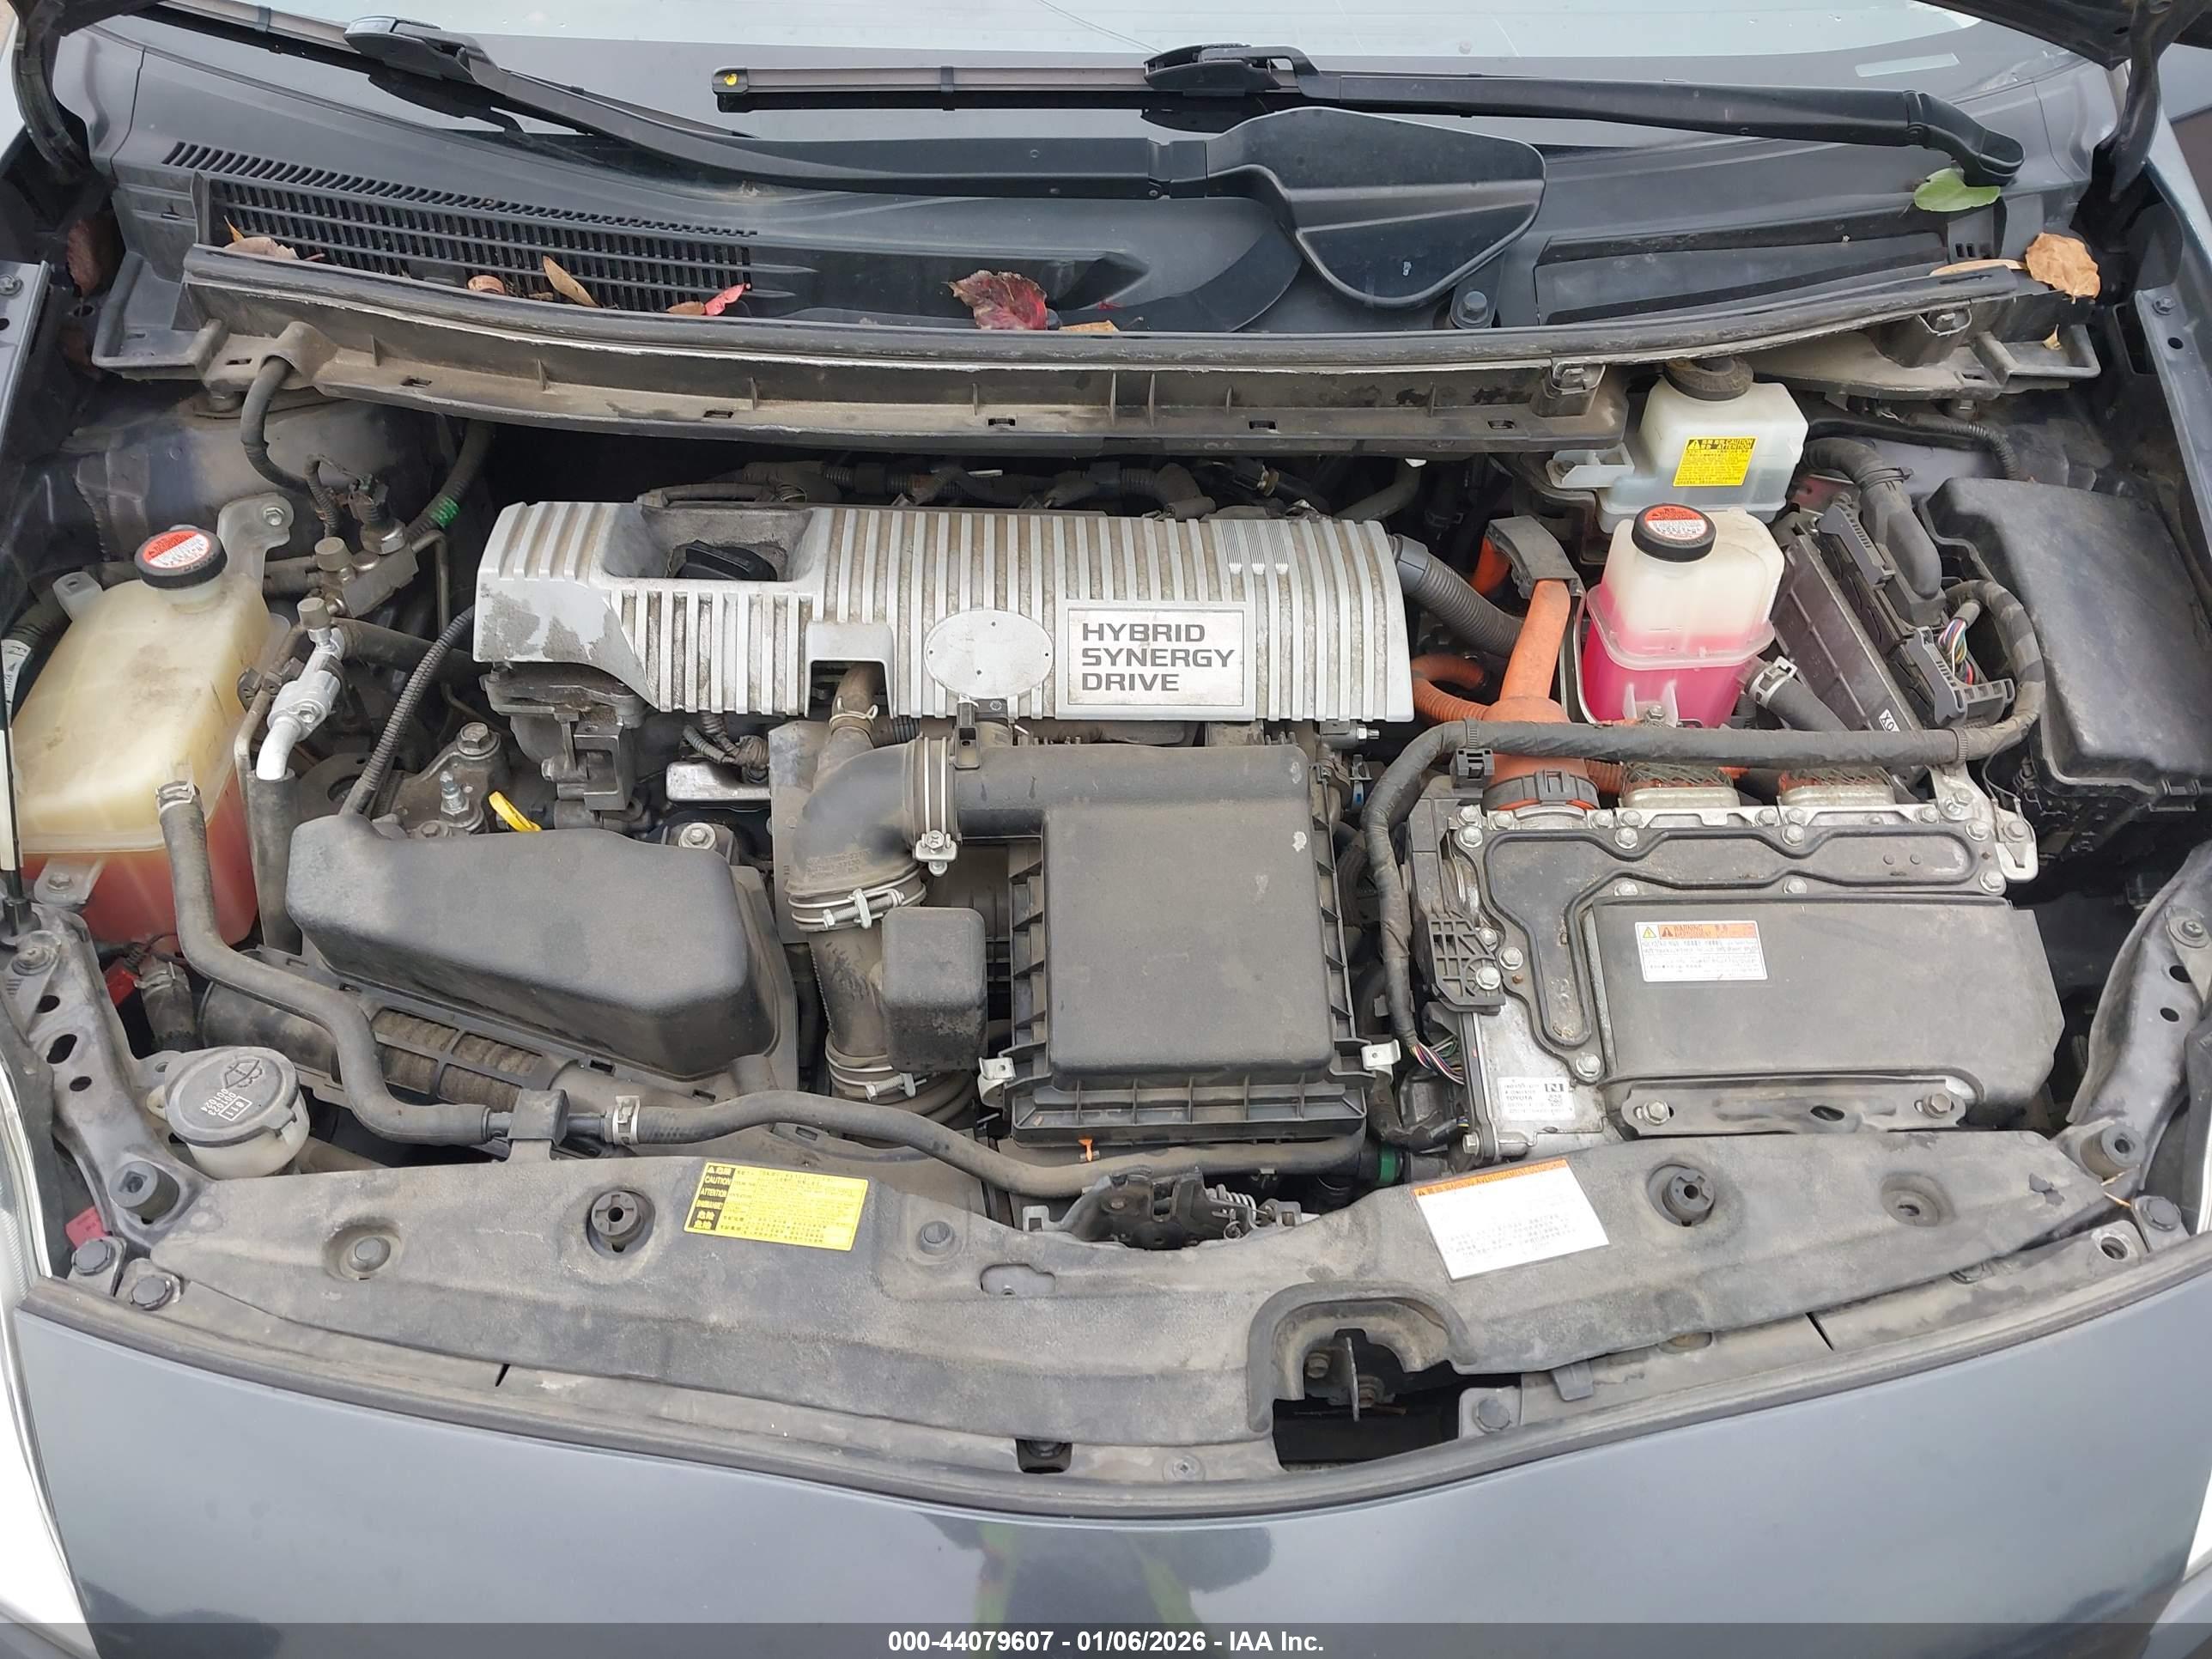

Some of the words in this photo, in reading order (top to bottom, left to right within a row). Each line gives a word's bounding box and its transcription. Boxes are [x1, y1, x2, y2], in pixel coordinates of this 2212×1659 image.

[1082, 623, 1206, 642] HYBRID
[1082, 648, 1235, 667] SYNERGY
[1082, 673, 1179, 691] DRIVE
[704, 1175, 731, 1186] CAUTION
[701, 1188, 728, 1198] ATTENTION
